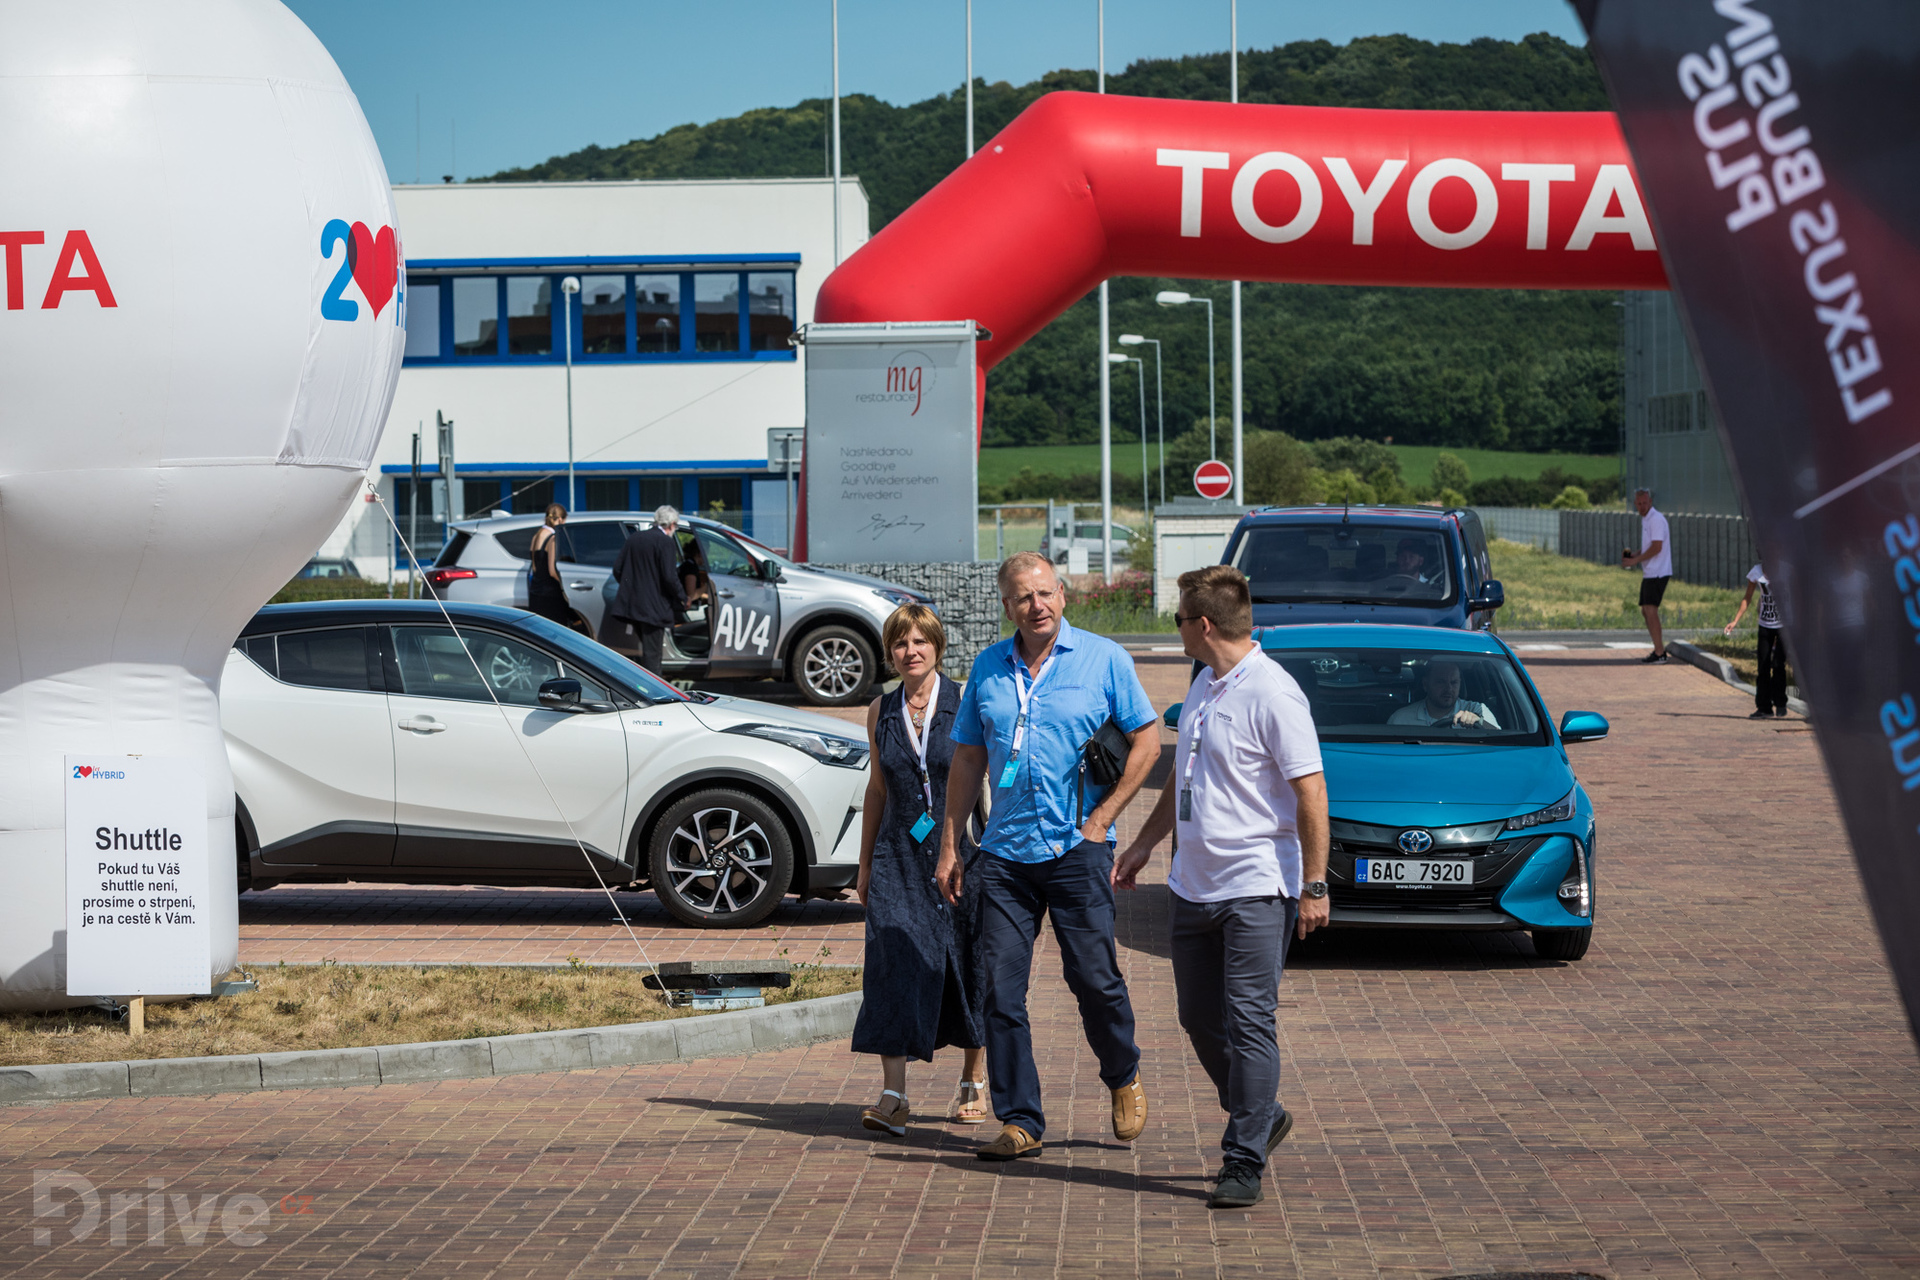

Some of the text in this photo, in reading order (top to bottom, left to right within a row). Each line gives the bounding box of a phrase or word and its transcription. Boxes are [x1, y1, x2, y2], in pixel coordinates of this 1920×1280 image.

[1156, 148, 1657, 251] TOYOTA
[886, 366, 922, 416] mg
[856, 392, 916, 403] restaurace
[841, 447, 913, 457] Nashledanou
[841, 461, 896, 472] Goodbye
[842, 475, 938, 485] Auf Wiedersehen
[842, 490, 902, 500] Arrivederci
[1216, 711, 1233, 722] TOYOTA
[93, 771, 125, 779] HYBRID
[96, 827, 182, 851] Shuttle
[99, 863, 180, 875] Pokud tu Váš
[1372, 862, 1405, 880] 6AC
[1420, 863, 1464, 881] 7920
[101, 880, 178, 892] shuttle není,
[83, 896, 195, 910] prosíme o strpení,
[82, 912, 195, 927] je na cestě k Vám.
